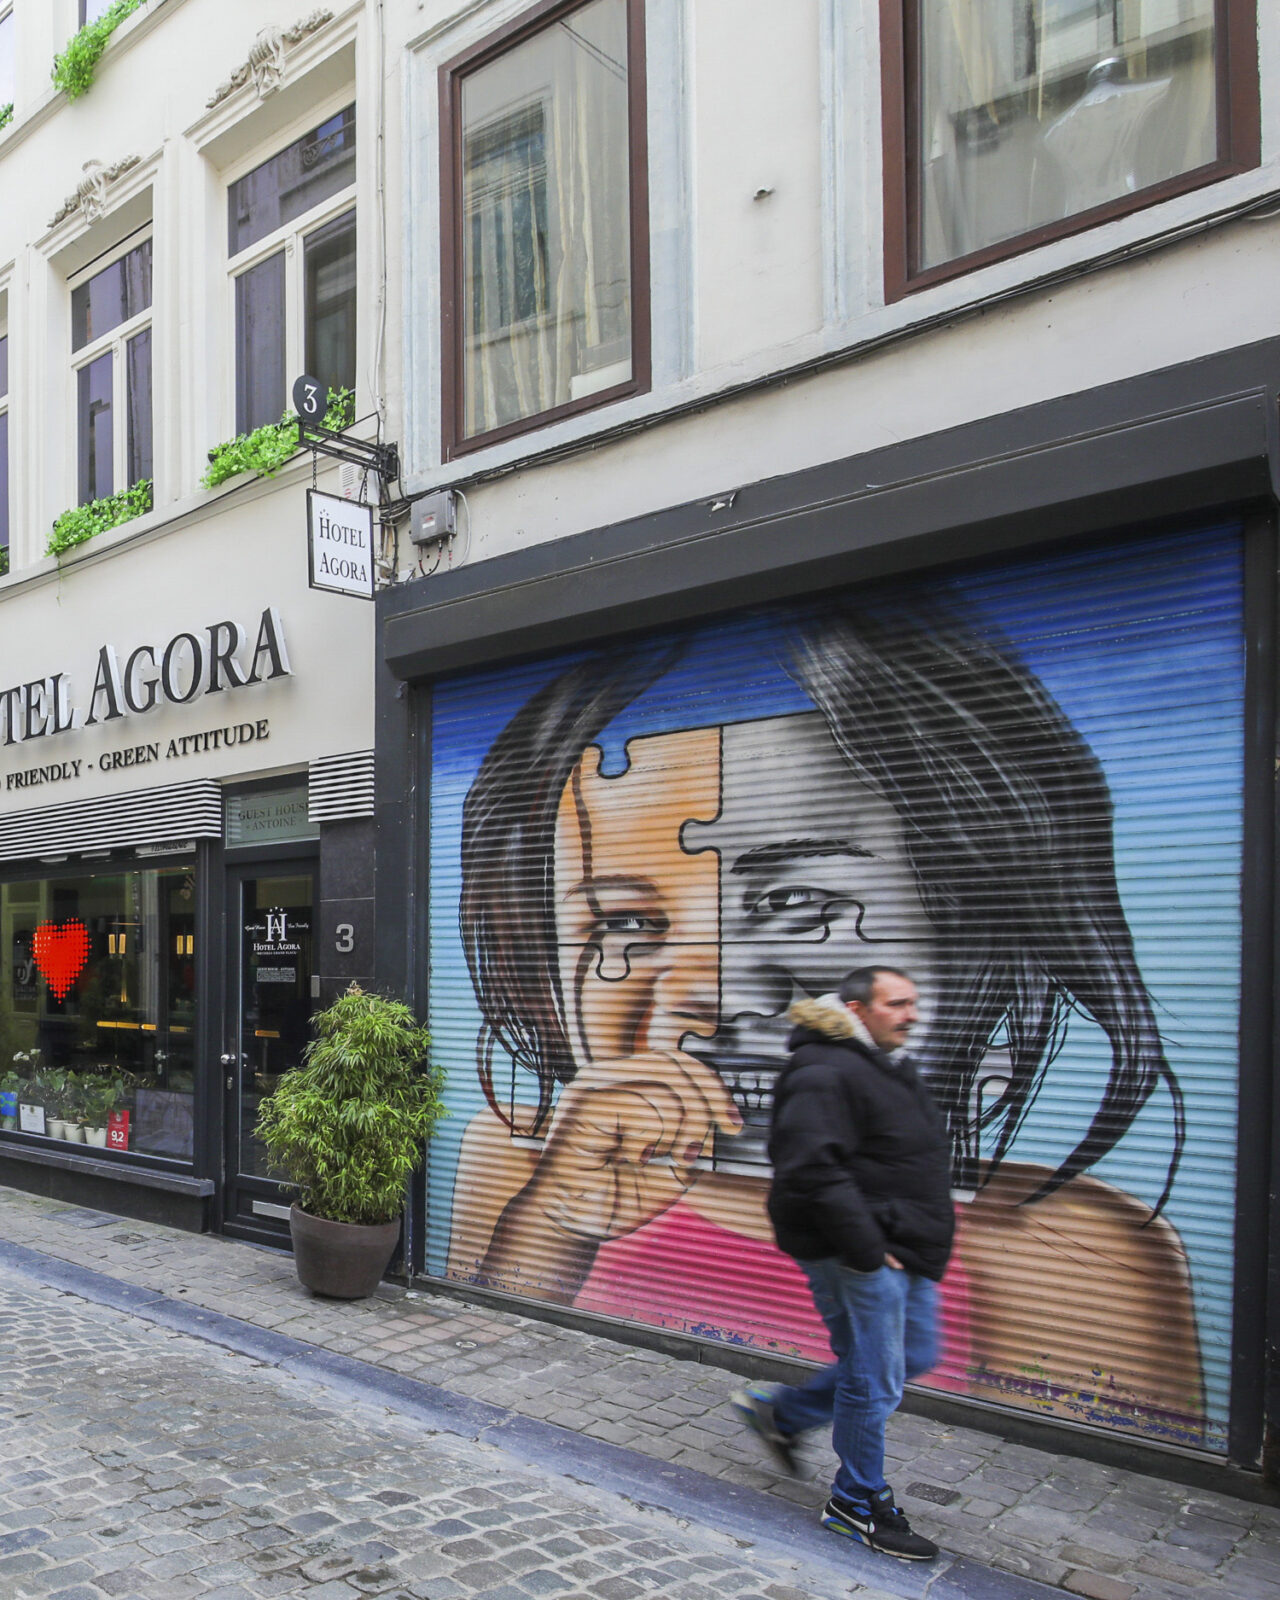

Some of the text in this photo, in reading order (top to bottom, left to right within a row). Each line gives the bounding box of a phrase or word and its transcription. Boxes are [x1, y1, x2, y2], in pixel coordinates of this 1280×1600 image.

[303, 383, 318, 414] 3
[318, 515, 366, 549] HOTEL
[319, 551, 368, 582] AGORA
[85, 606, 293, 726] AGORA
[6, 759, 82, 792] FRIENDLY
[99, 743, 160, 772] GREEN
[166, 719, 270, 758] ATTITUDE
[239, 810, 270, 822] GUEST
[253, 943, 276, 951] HOTEL
[335, 923, 354, 953] 3
